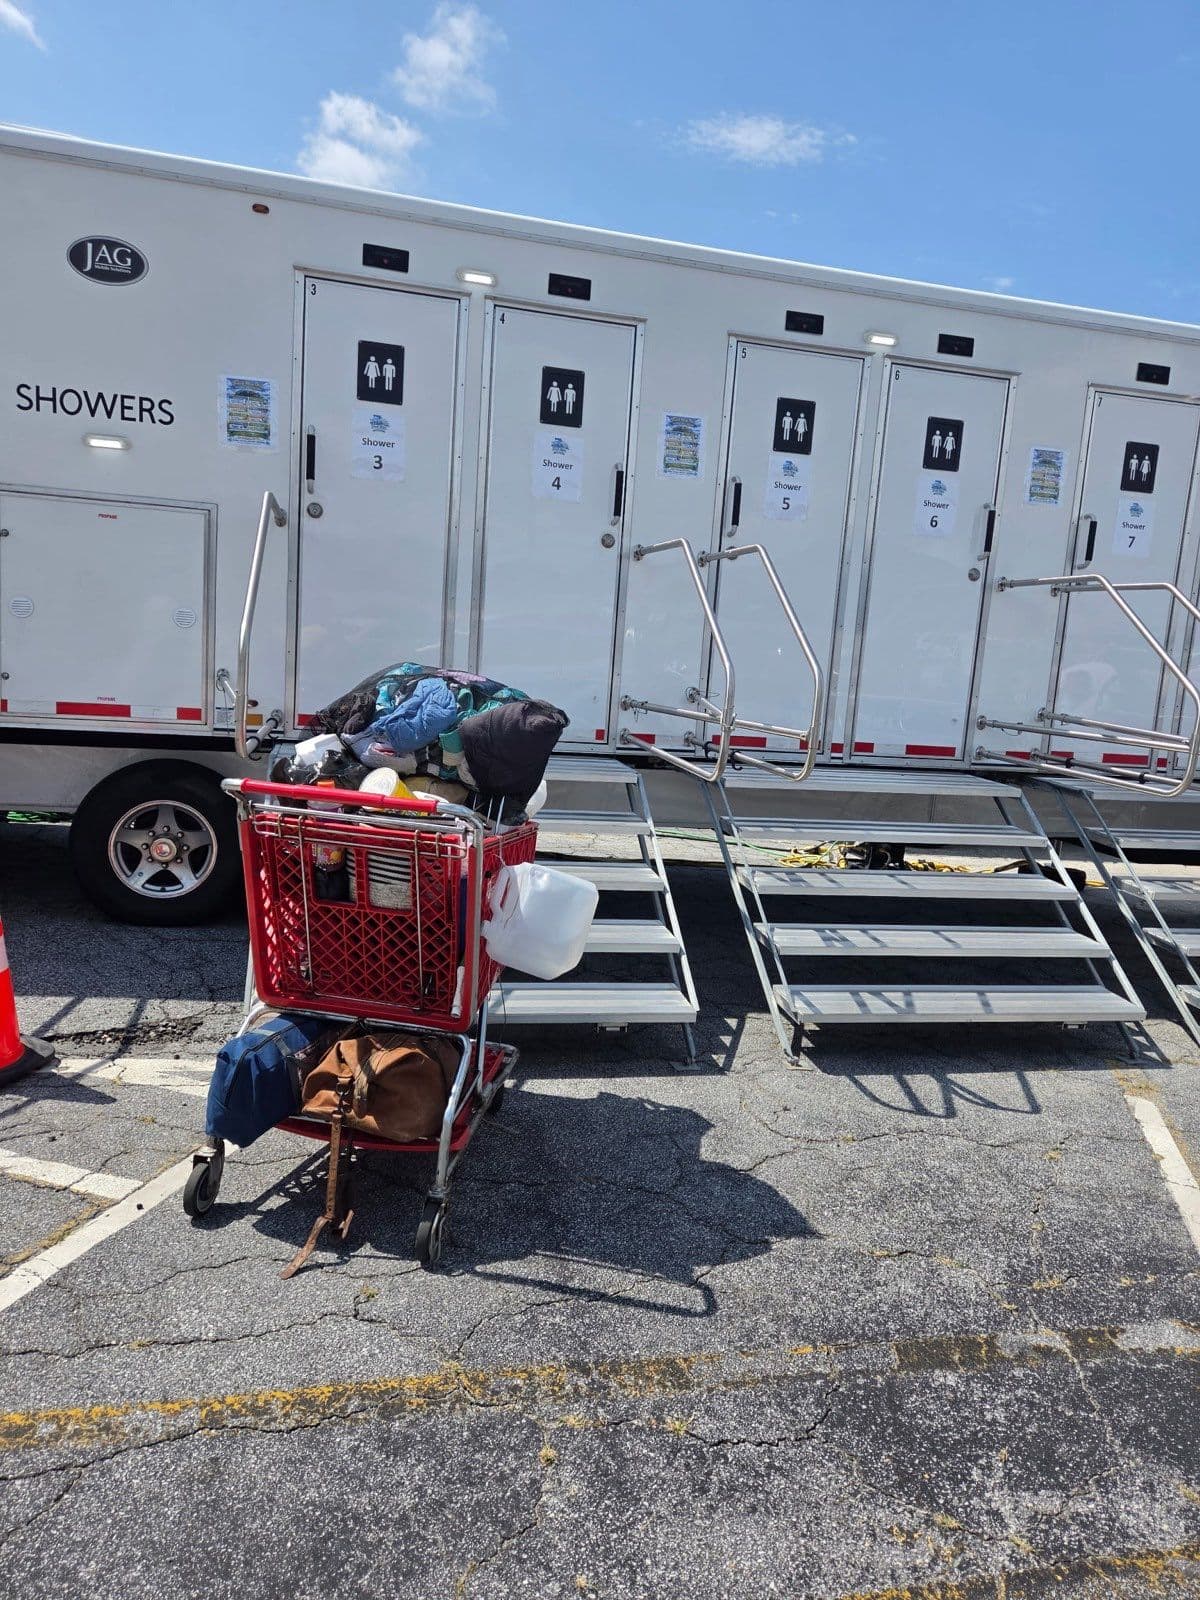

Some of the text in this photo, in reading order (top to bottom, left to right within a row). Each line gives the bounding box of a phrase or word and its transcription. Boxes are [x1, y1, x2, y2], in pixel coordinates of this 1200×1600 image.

[83, 242, 131, 272] JAG
[310, 283, 317, 296] 3
[499, 312, 506, 325] 4
[741, 347, 747, 359] 5
[894, 369, 901, 381] 6
[16, 383, 175, 426] SHOWERS
[361, 437, 396, 448] Shower
[373, 455, 383, 470] 3
[542, 458, 574, 470] Shower
[551, 476, 562, 491] 4
[773, 481, 802, 491] Shower
[781, 497, 791, 510] 5
[923, 499, 950, 510] Shower
[930, 515, 939, 528] 6
[1121, 521, 1146, 531] Shower
[1128, 535, 1136, 548] 7
